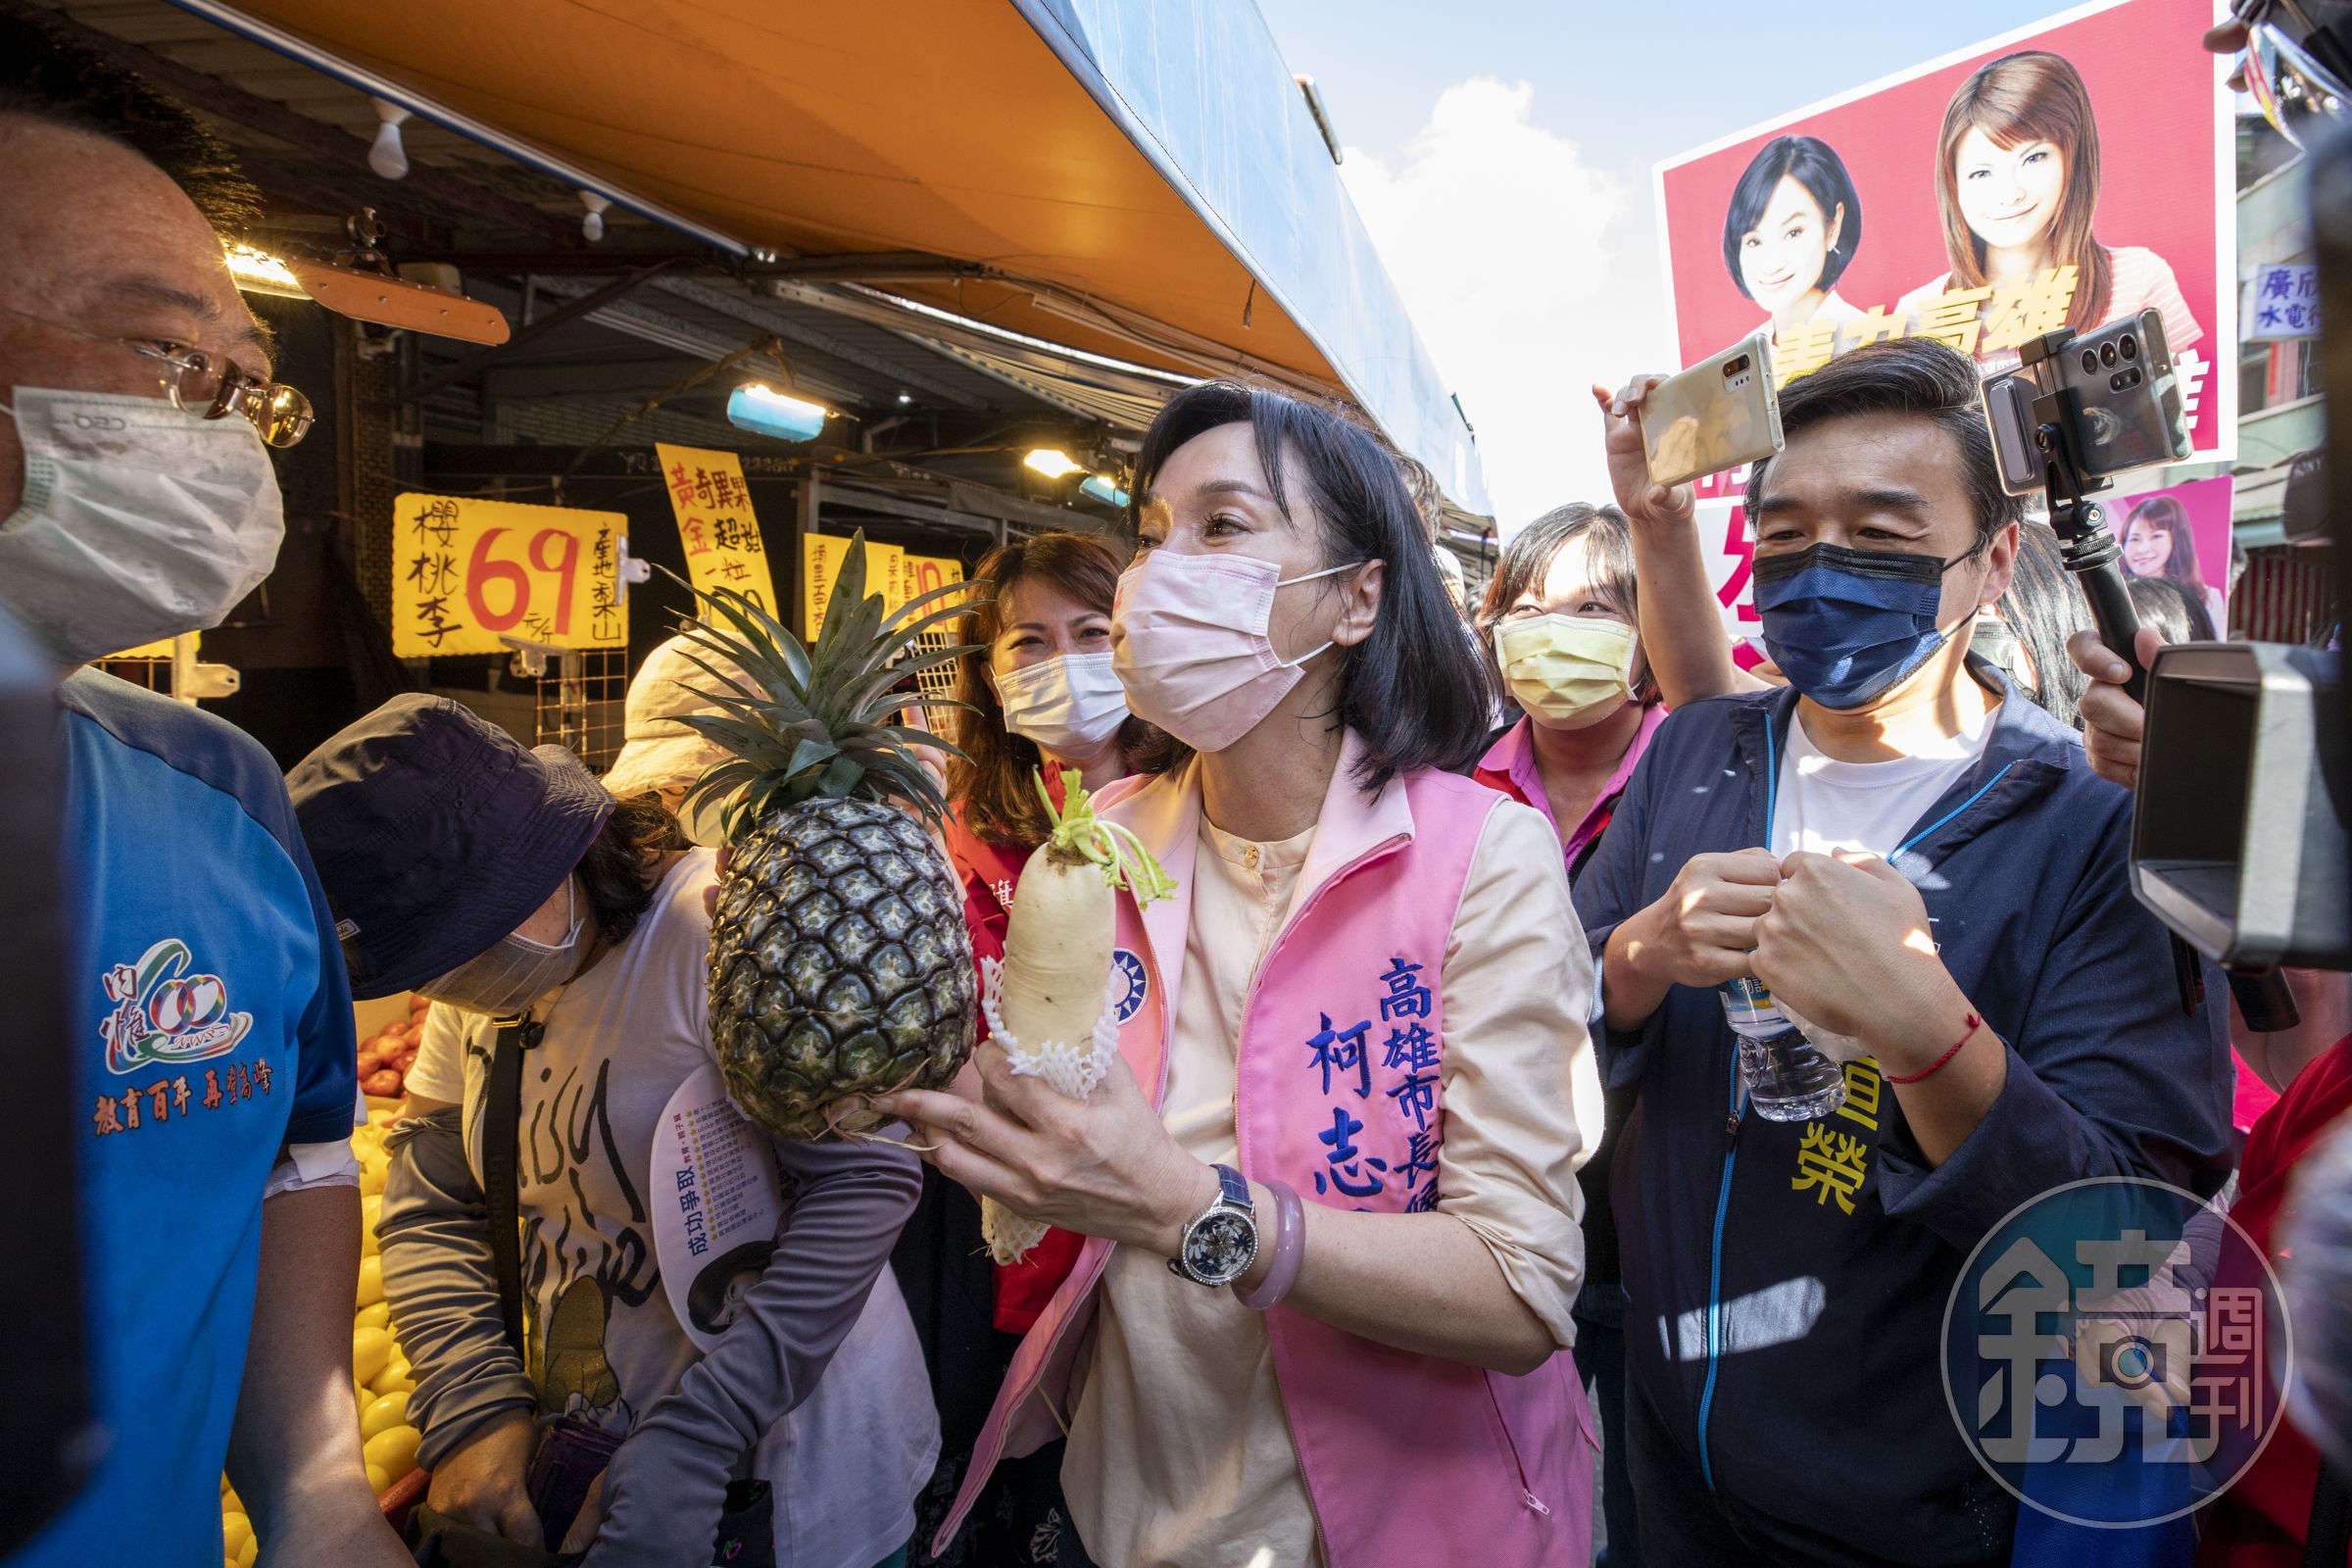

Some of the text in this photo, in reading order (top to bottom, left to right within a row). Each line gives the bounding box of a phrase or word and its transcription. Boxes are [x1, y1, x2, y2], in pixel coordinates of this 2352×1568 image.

[407, 500, 463, 648] 櫻桃李
[466, 527, 580, 636] 69
[94, 1075, 193, 1137] 教育百年
[1306, 1012, 1388, 1212] 柯志
[675, 1164, 709, 1257] 成功爭取
